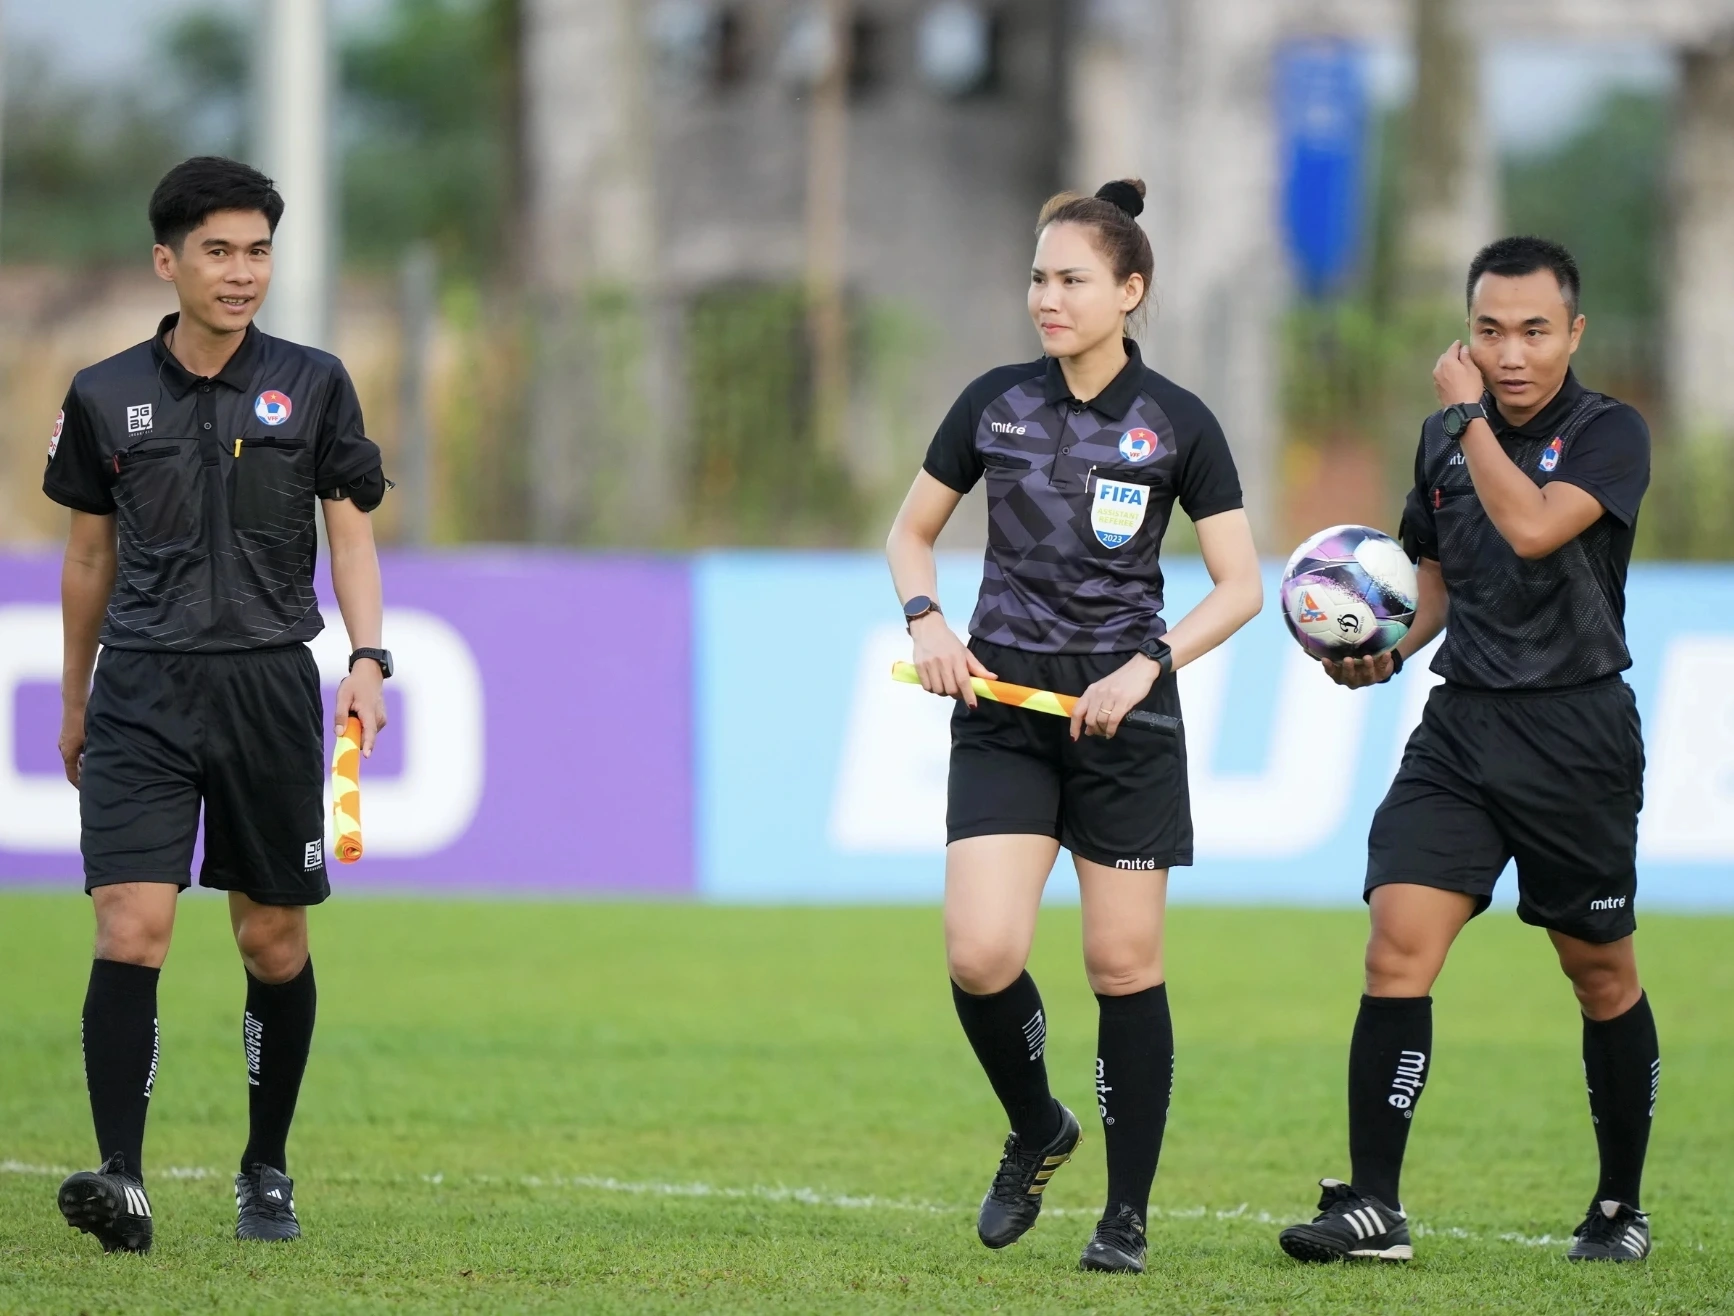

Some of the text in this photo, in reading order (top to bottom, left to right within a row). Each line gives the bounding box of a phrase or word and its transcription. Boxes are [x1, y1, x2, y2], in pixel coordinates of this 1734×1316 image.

[1100, 484, 1142, 505] FIFA
[1096, 508, 1140, 520] ASSISTANT
[1098, 516, 1134, 527] REFEREE
[1102, 534, 1123, 543] 2023
[1115, 857, 1155, 870] mitre
[1590, 895, 1627, 910] mitre
